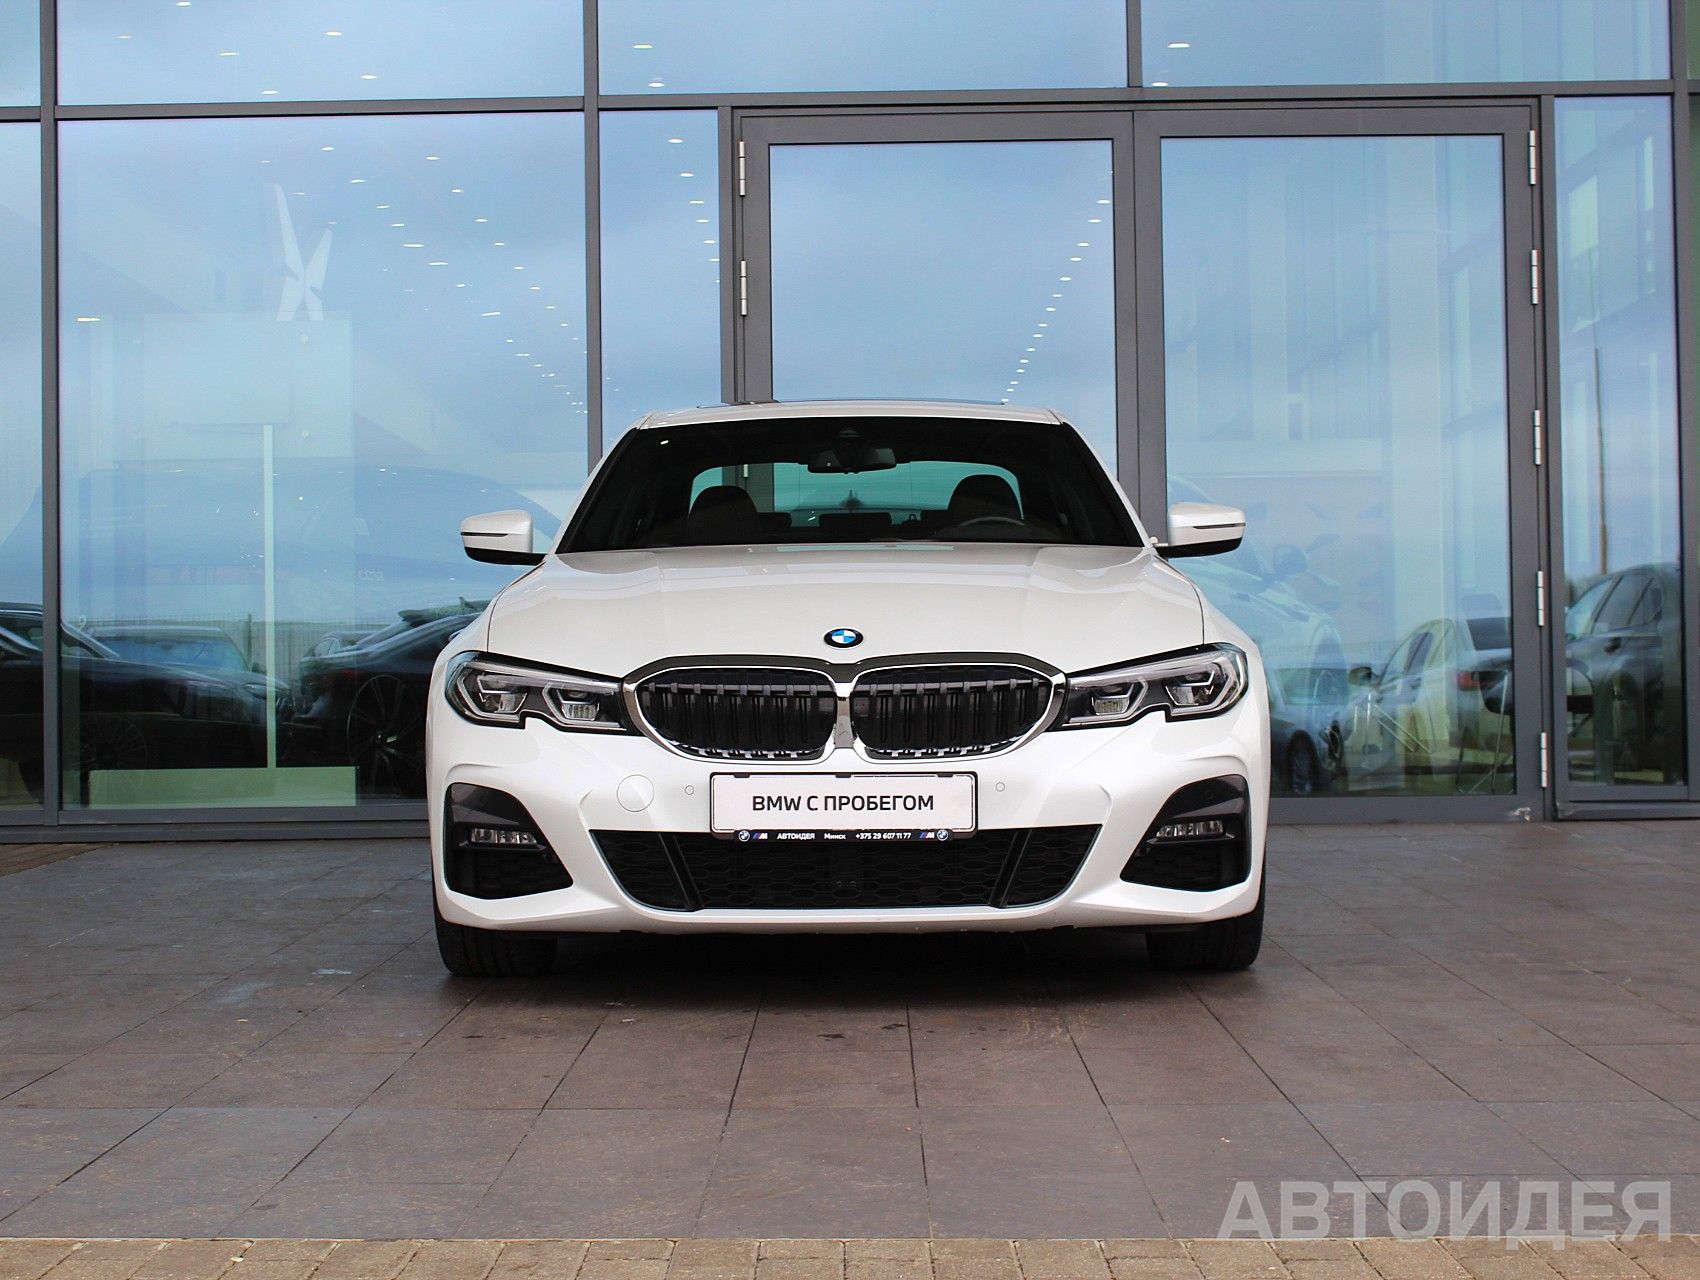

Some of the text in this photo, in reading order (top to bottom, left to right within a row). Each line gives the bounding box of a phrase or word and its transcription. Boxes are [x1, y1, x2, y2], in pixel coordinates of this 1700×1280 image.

[752, 795, 801, 811] BMW
[824, 795, 934, 811] ПРОБЕГОМ
[776, 832, 816, 841] АВТОИДЕЯ
[823, 832, 847, 840] Минск
[855, 832, 872, 840] +375
[872, 832, 882, 840] 29
[882, 832, 895, 840] 607
[896, 832, 903, 840] 11
[903, 832, 912, 840] 77
